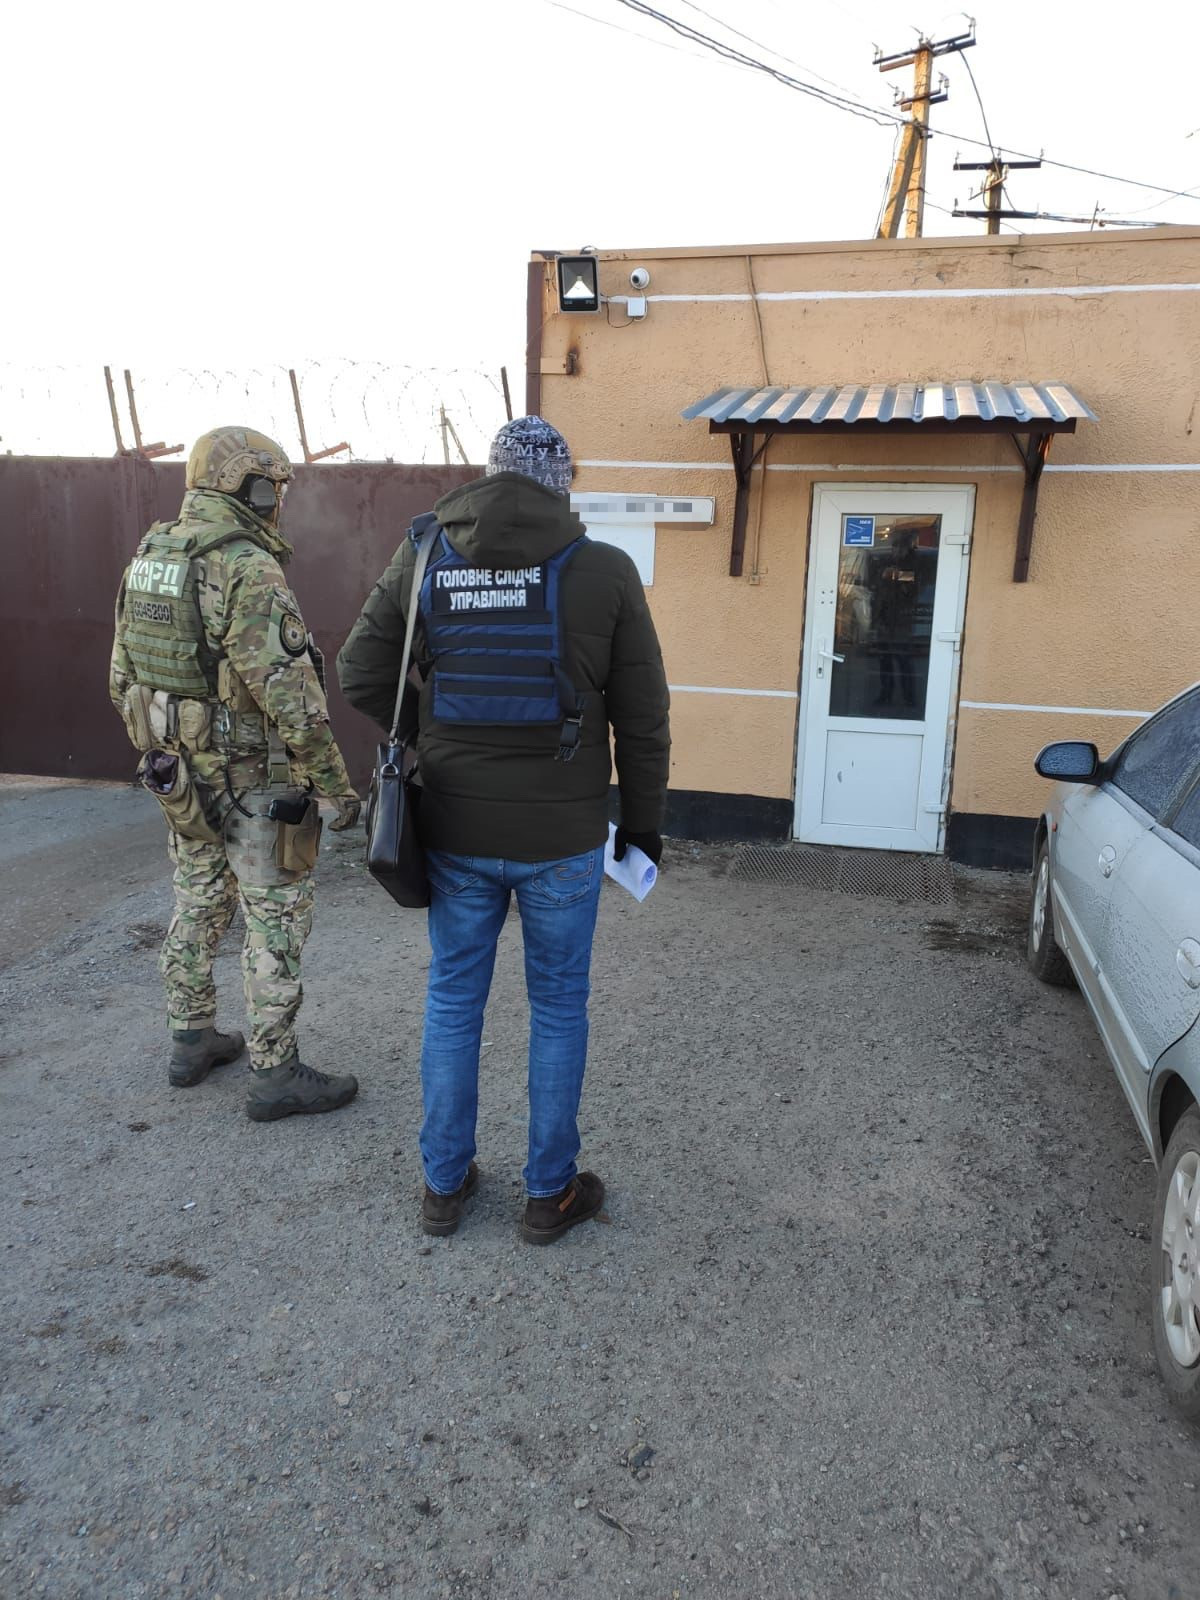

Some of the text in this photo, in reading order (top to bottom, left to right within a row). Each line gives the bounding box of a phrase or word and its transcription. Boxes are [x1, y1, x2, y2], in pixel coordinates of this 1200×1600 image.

[516, 444, 548, 461] My
[127, 559, 180, 596] КОРД
[436, 566, 541, 589] ГОЛОВНЕ СЛІДЧЕ
[449, 588, 527, 611] УПРАВЛІННЯ
